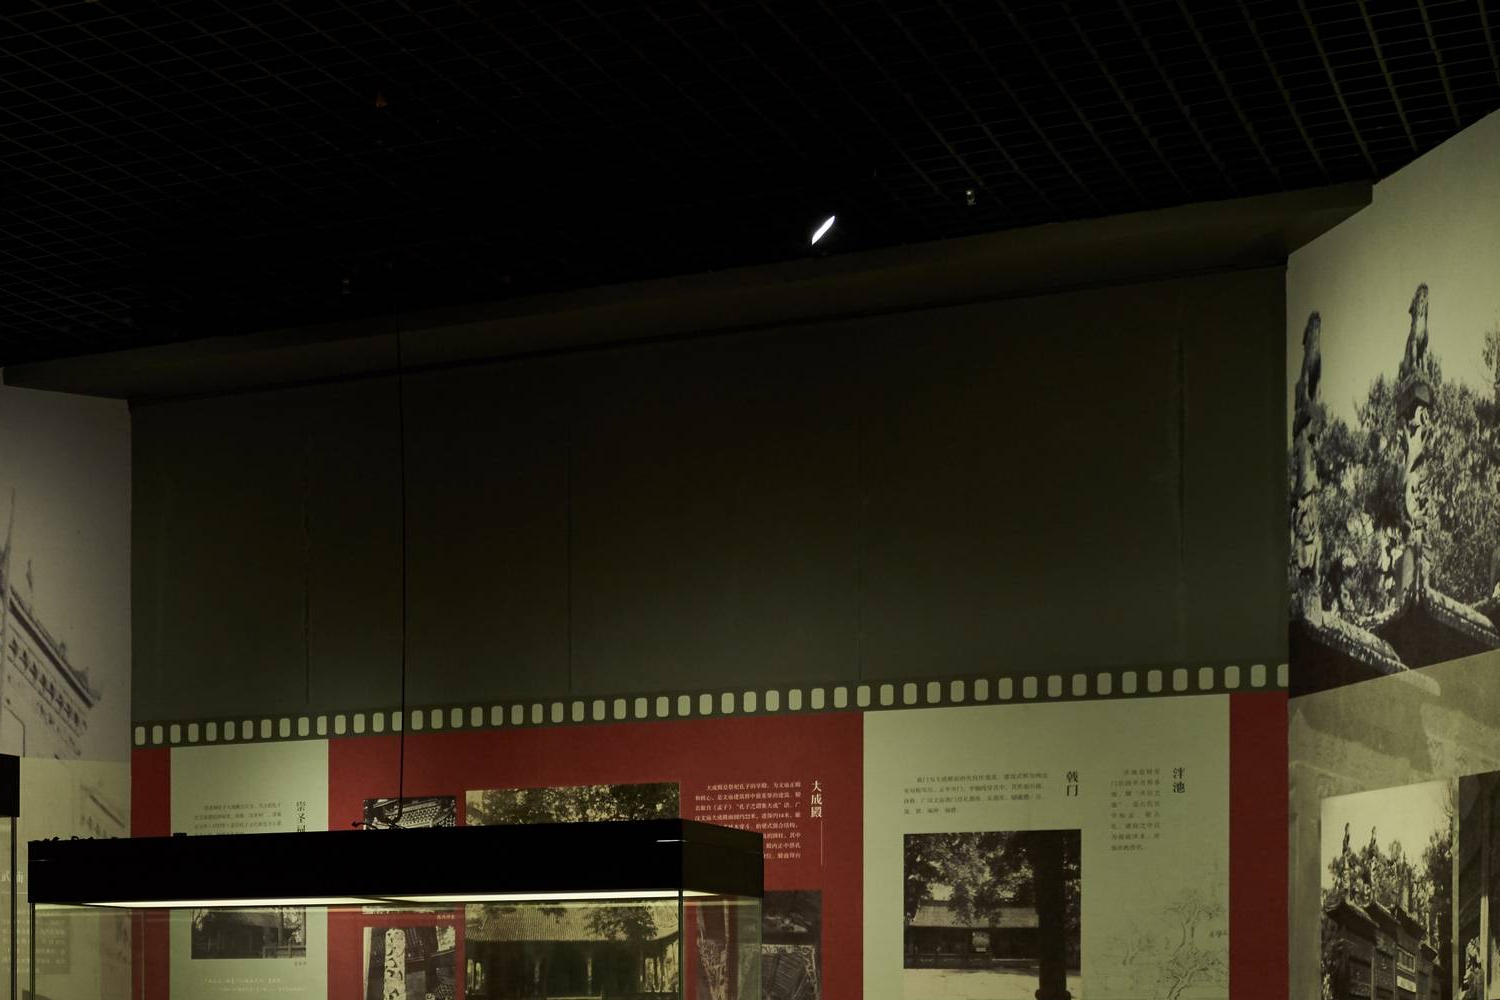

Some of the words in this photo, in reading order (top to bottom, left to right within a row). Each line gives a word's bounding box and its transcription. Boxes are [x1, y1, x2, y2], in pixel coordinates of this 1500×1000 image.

[1066, 770, 1079, 798] 戟门
[1172, 767, 1186, 794] 泮池
[810, 779, 823, 819] 大成殿
